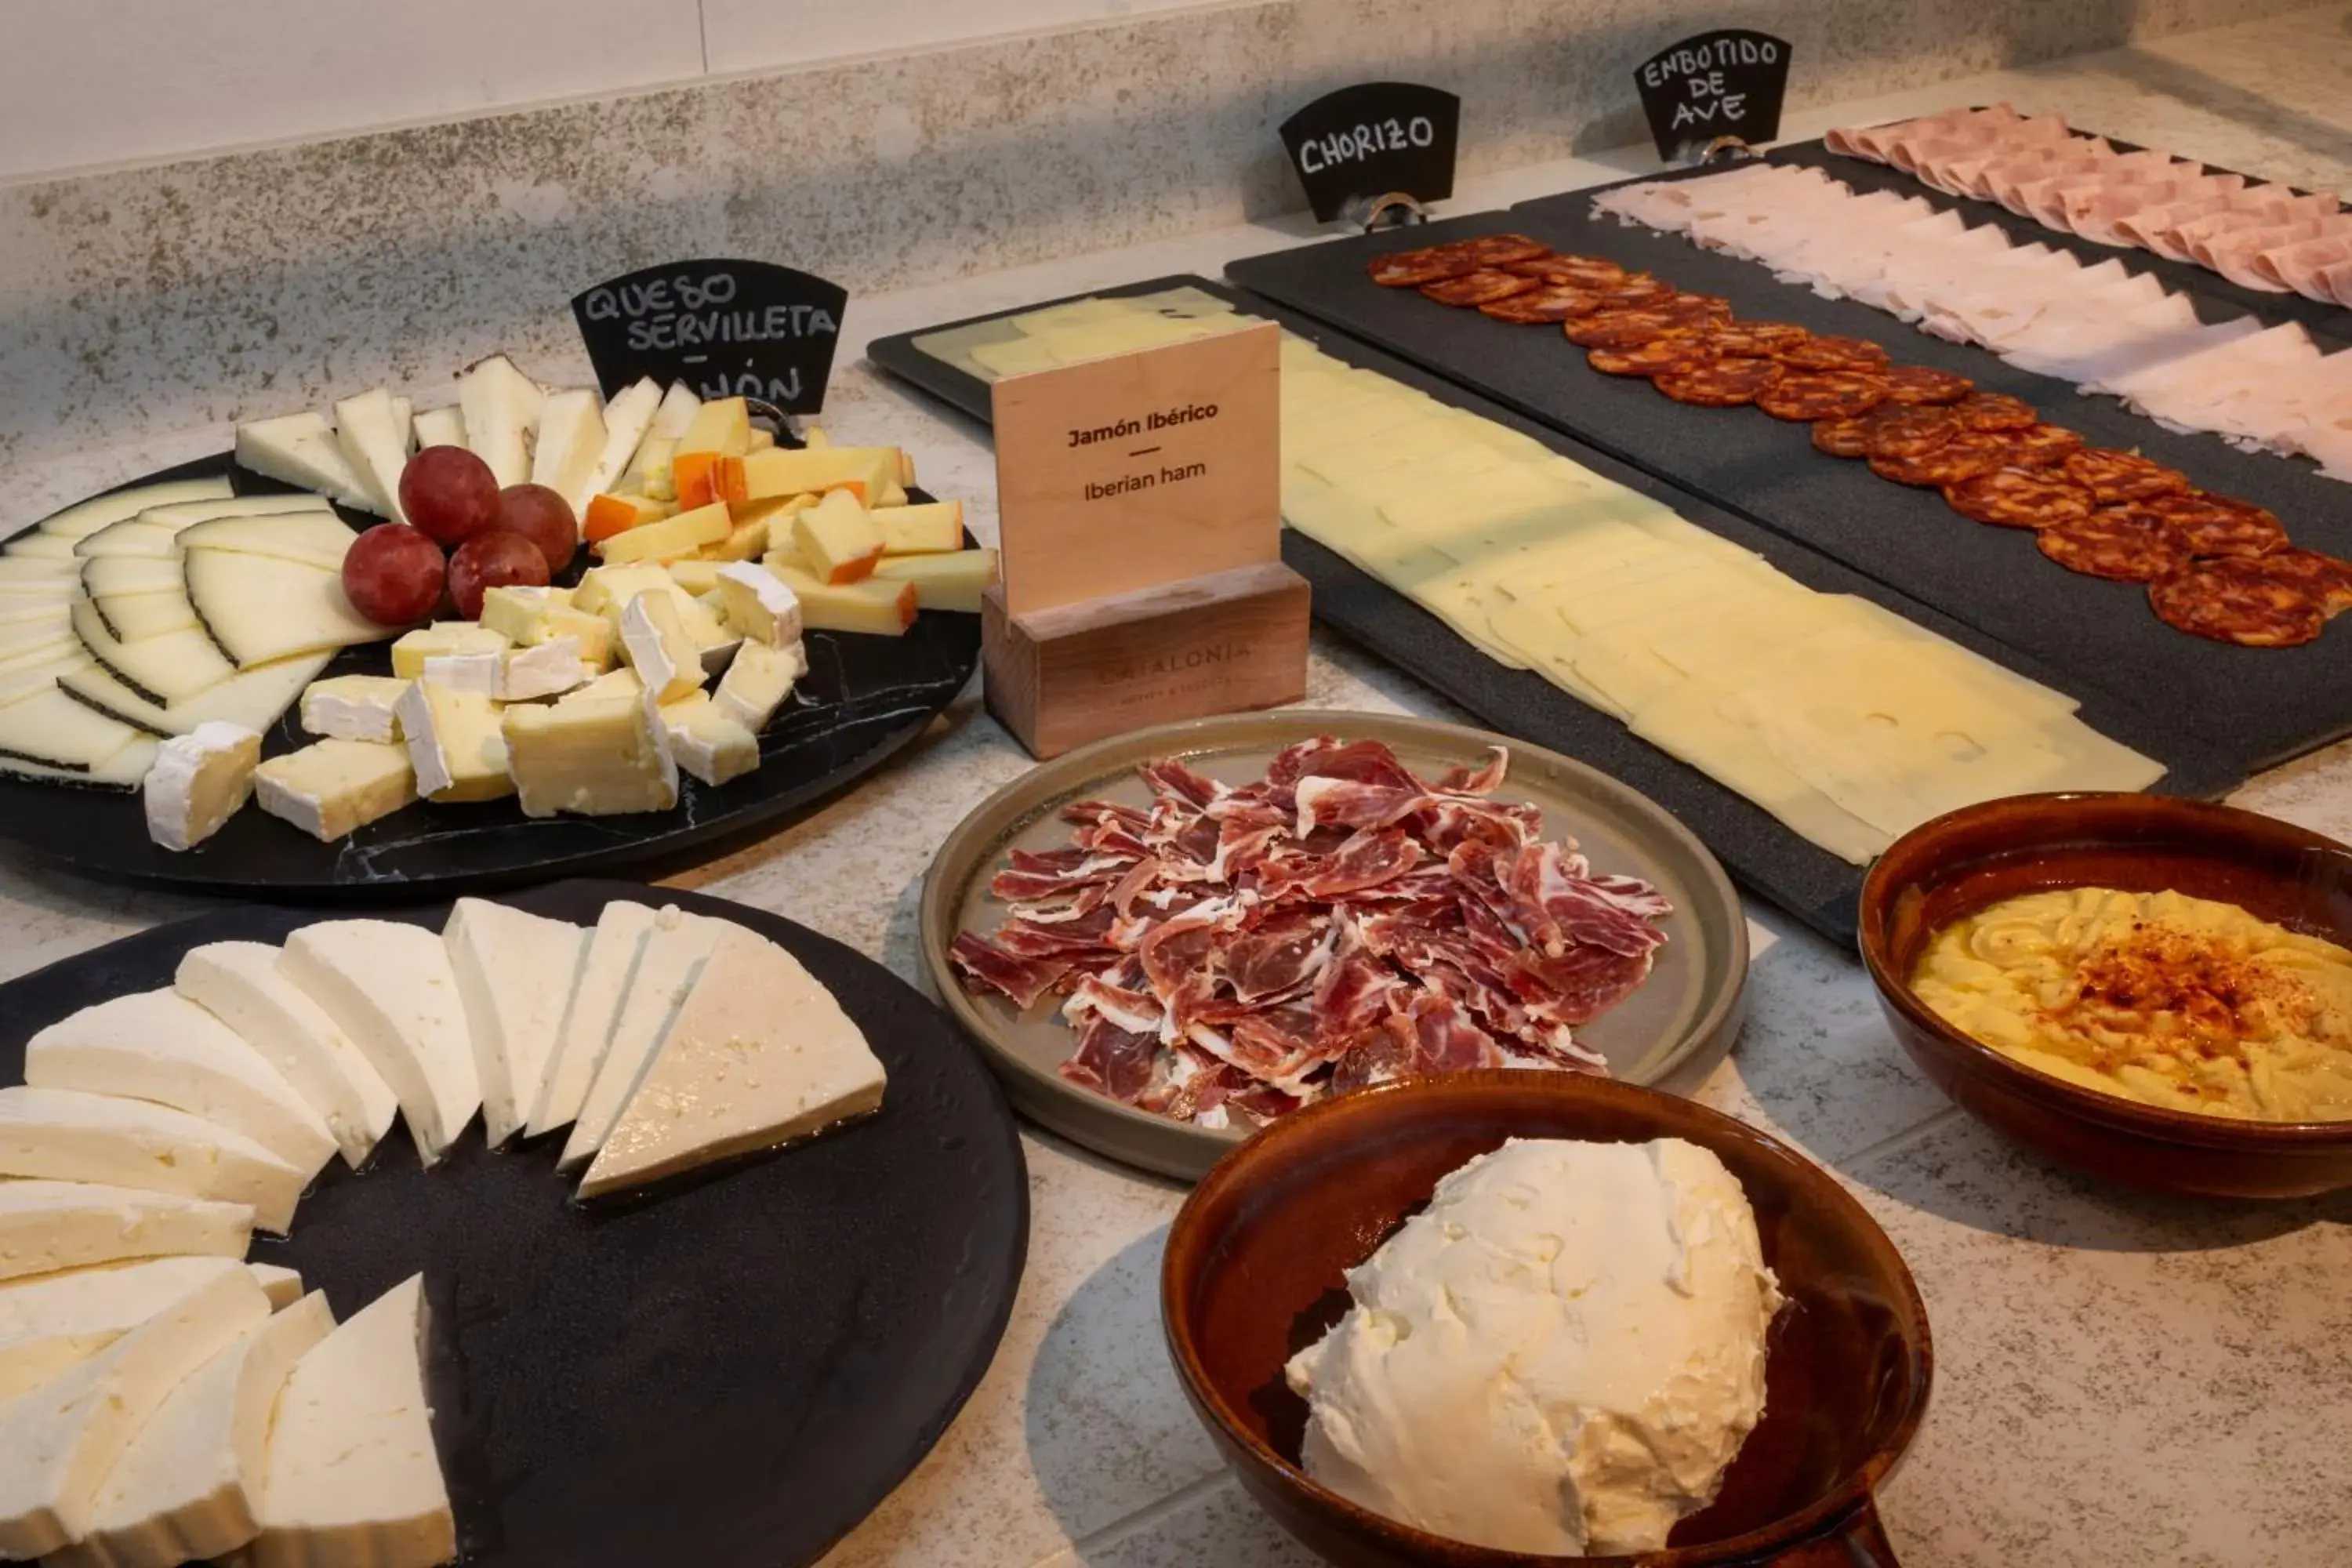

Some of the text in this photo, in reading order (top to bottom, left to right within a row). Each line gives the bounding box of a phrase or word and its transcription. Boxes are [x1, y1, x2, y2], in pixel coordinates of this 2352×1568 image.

[1687, 71, 1726, 100] DE
[1671, 92, 1747, 131] AVE
[1299, 115, 1434, 174] CHORIZO
[585, 273, 736, 321] QUESO
[627, 304, 837, 350] SERVILLETA
[675, 358, 804, 401] HÓN
[1067, 402, 1218, 448] Jamón Ibérico
[1084, 462, 1207, 502] Iberian ham
